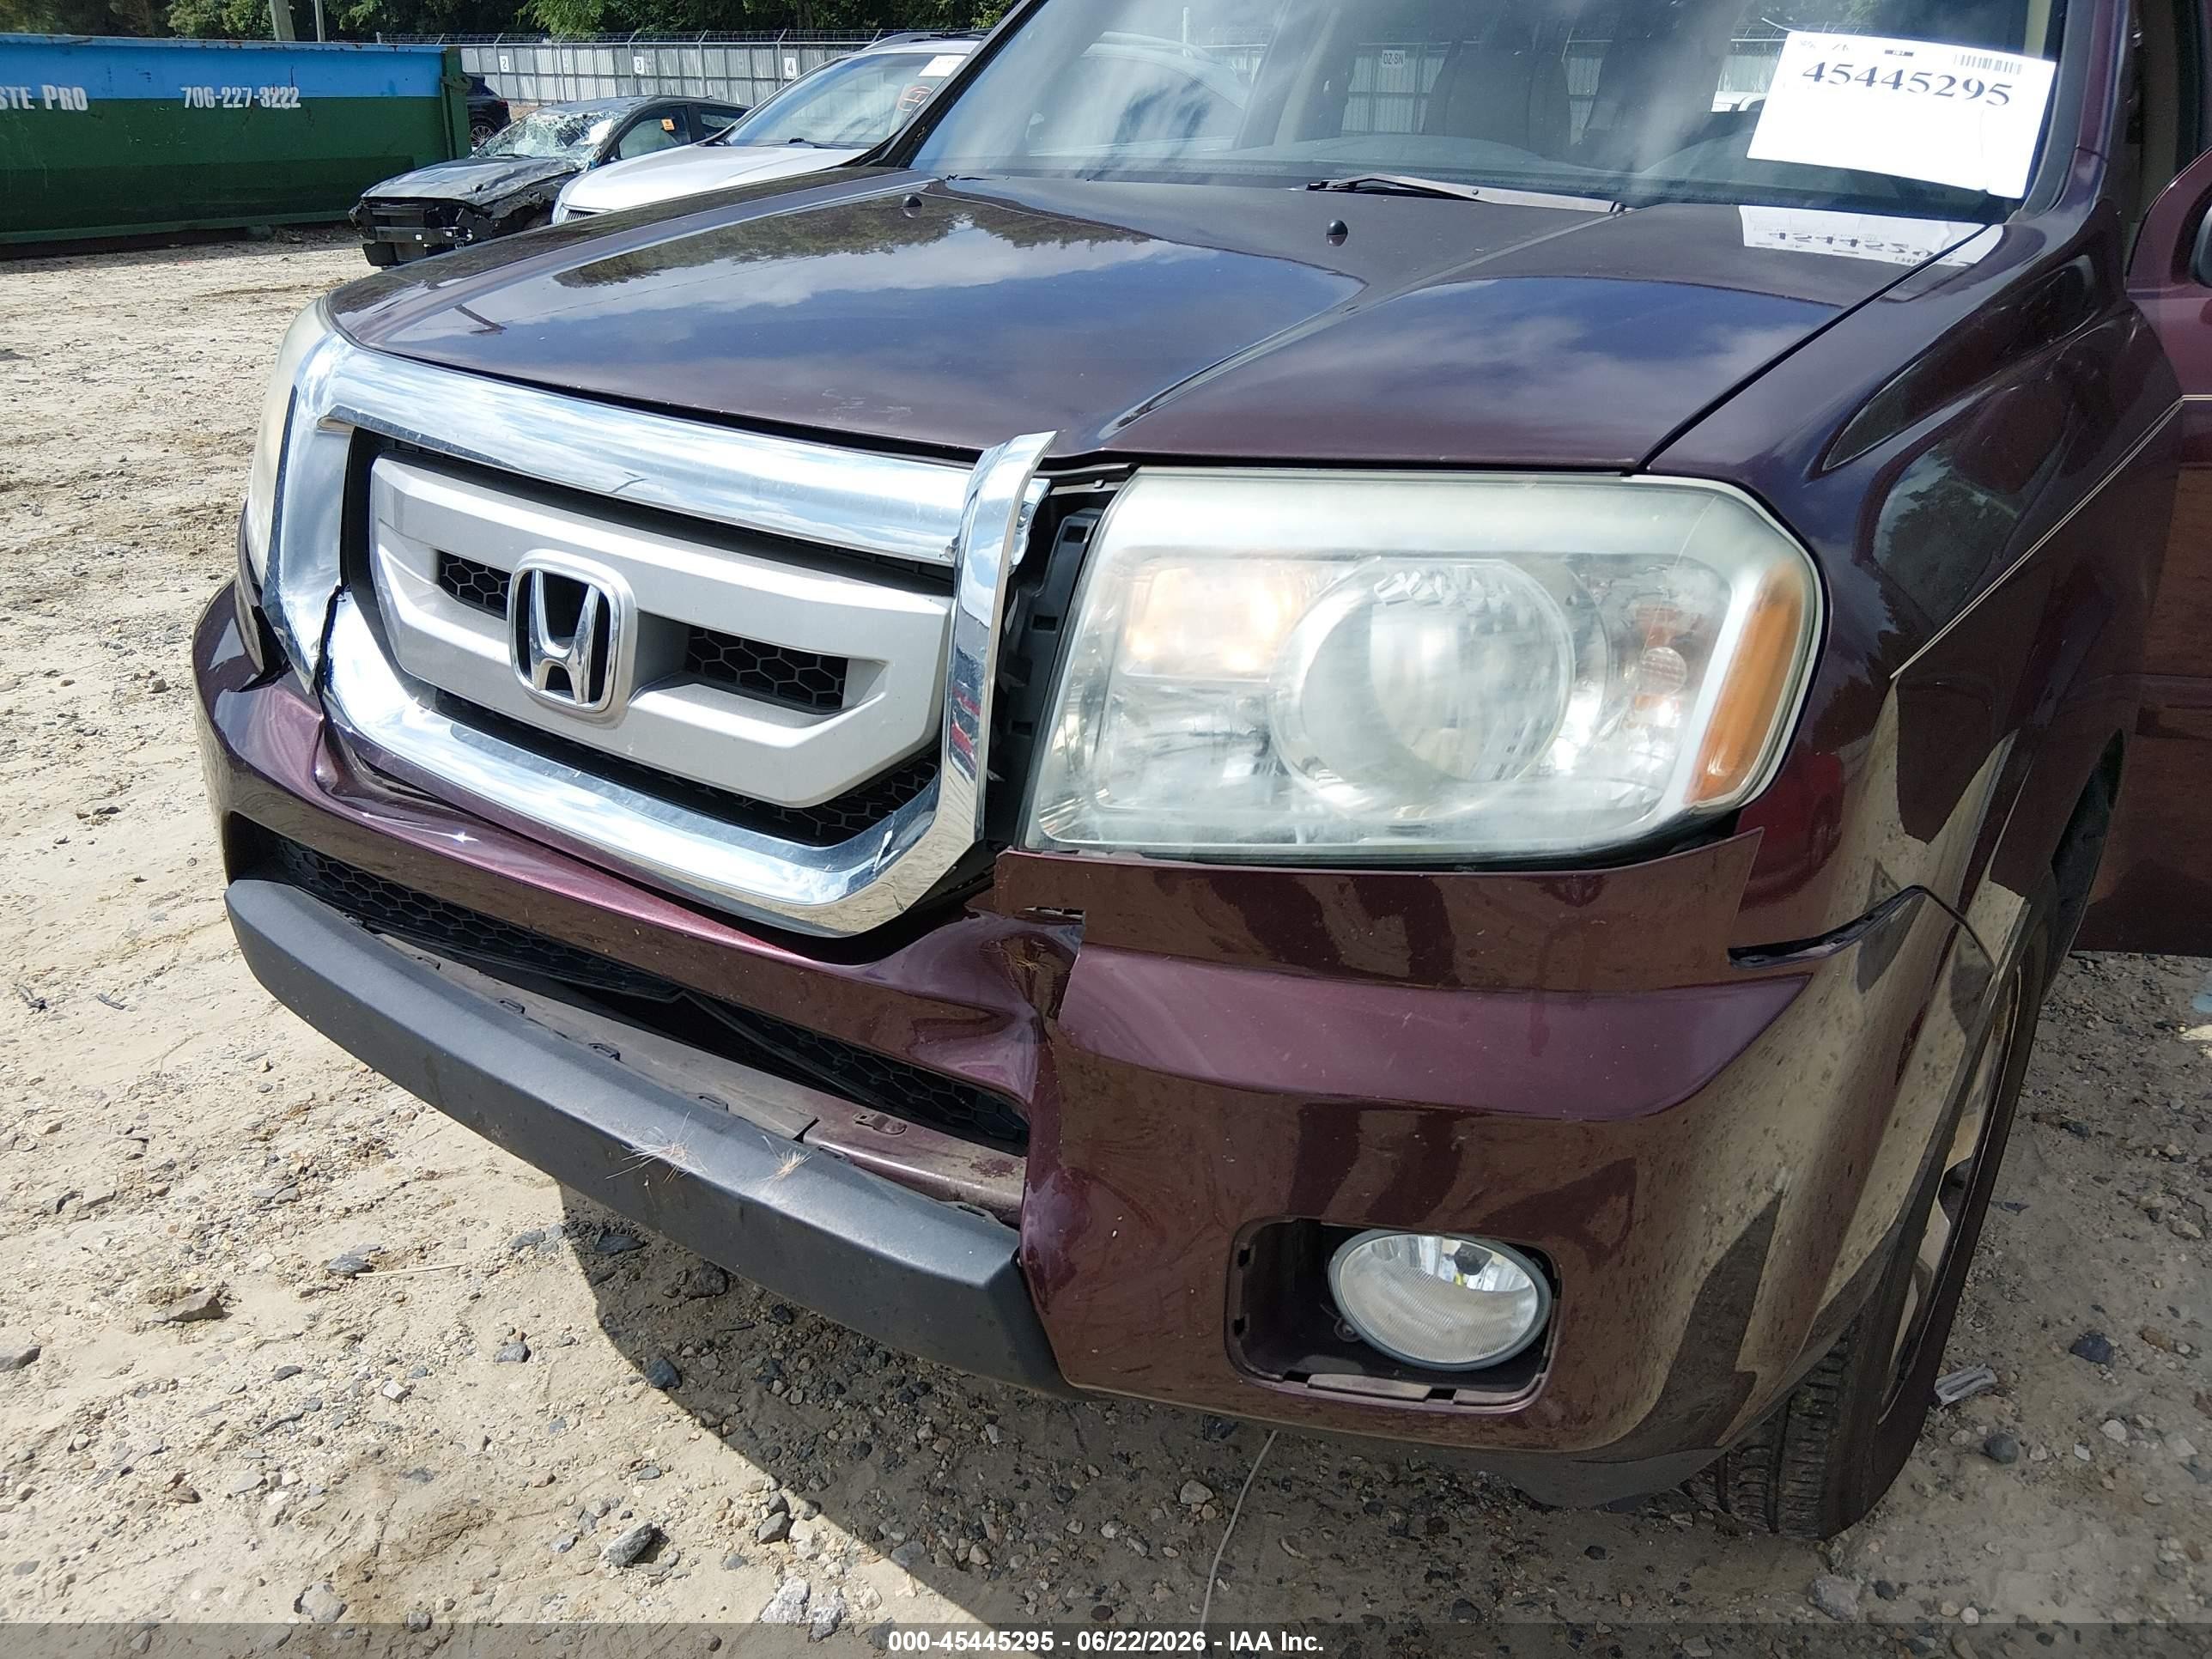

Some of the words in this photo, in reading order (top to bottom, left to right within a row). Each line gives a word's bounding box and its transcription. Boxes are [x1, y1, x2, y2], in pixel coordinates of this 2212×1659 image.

[41, 84, 88, 111] PRO
[1802, 62, 2013, 106] 45445295
[180, 87, 301, 109] 706-227-3222
